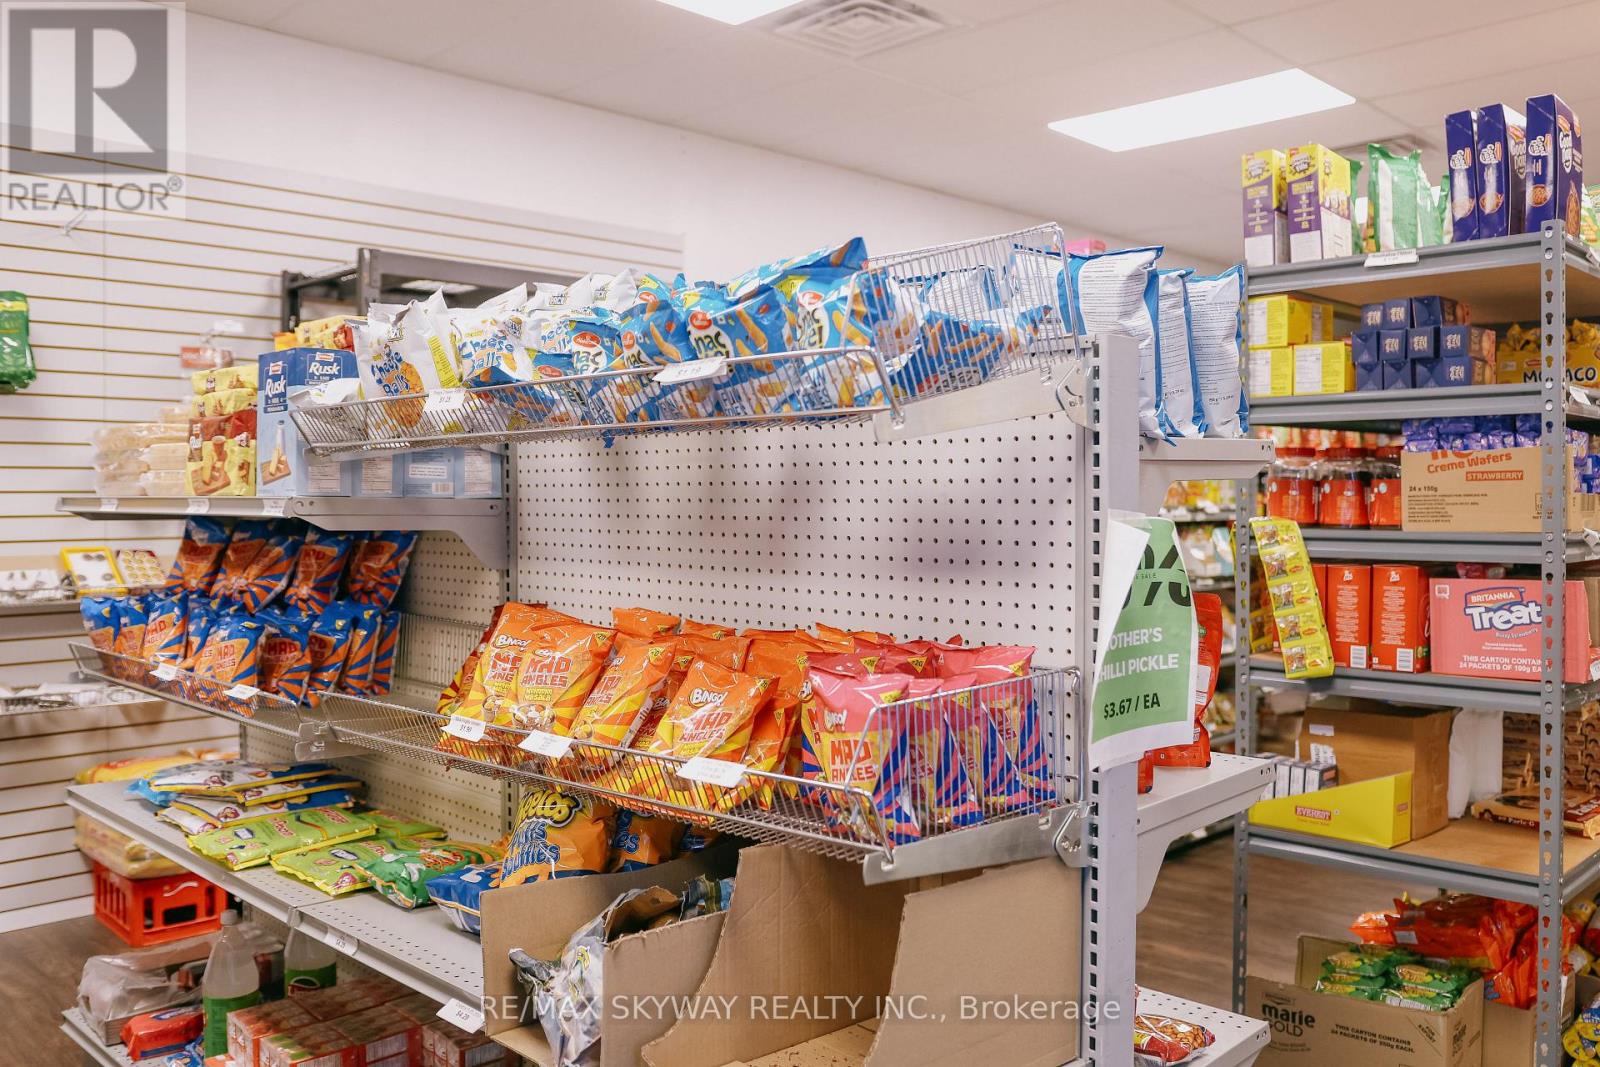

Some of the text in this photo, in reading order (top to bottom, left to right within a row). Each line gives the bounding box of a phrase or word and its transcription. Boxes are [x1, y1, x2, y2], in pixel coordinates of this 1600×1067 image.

[309, 362, 340, 376] Rusk
[265, 375, 286, 398] Rusk
[1427, 461, 1465, 474] Creme
[1467, 452, 1513, 468] Wafers
[1467, 472, 1523, 480] STRAWBERRY
[1471, 591, 1516, 603] BRITANNIA
[1465, 601, 1542, 630] Treat
[1107, 627, 1163, 652] OTHER'S
[526, 656, 571, 674] MAD
[1098, 653, 1180, 682] HILLI PICKLE
[1468, 662, 1501, 670] PACKETS
[521, 674, 568, 688] ANGLES
[689, 688, 729, 706] BINGO!
[1104, 692, 1161, 720] $3.67 / EA
[830, 739, 873, 765] MAD
[1262, 1003, 1315, 1028] marie
[1339, 1031, 1368, 1043] PACKETS
[1351, 1027, 1377, 1038] CARTON
[1378, 1034, 1412, 1046] CONTAINS
